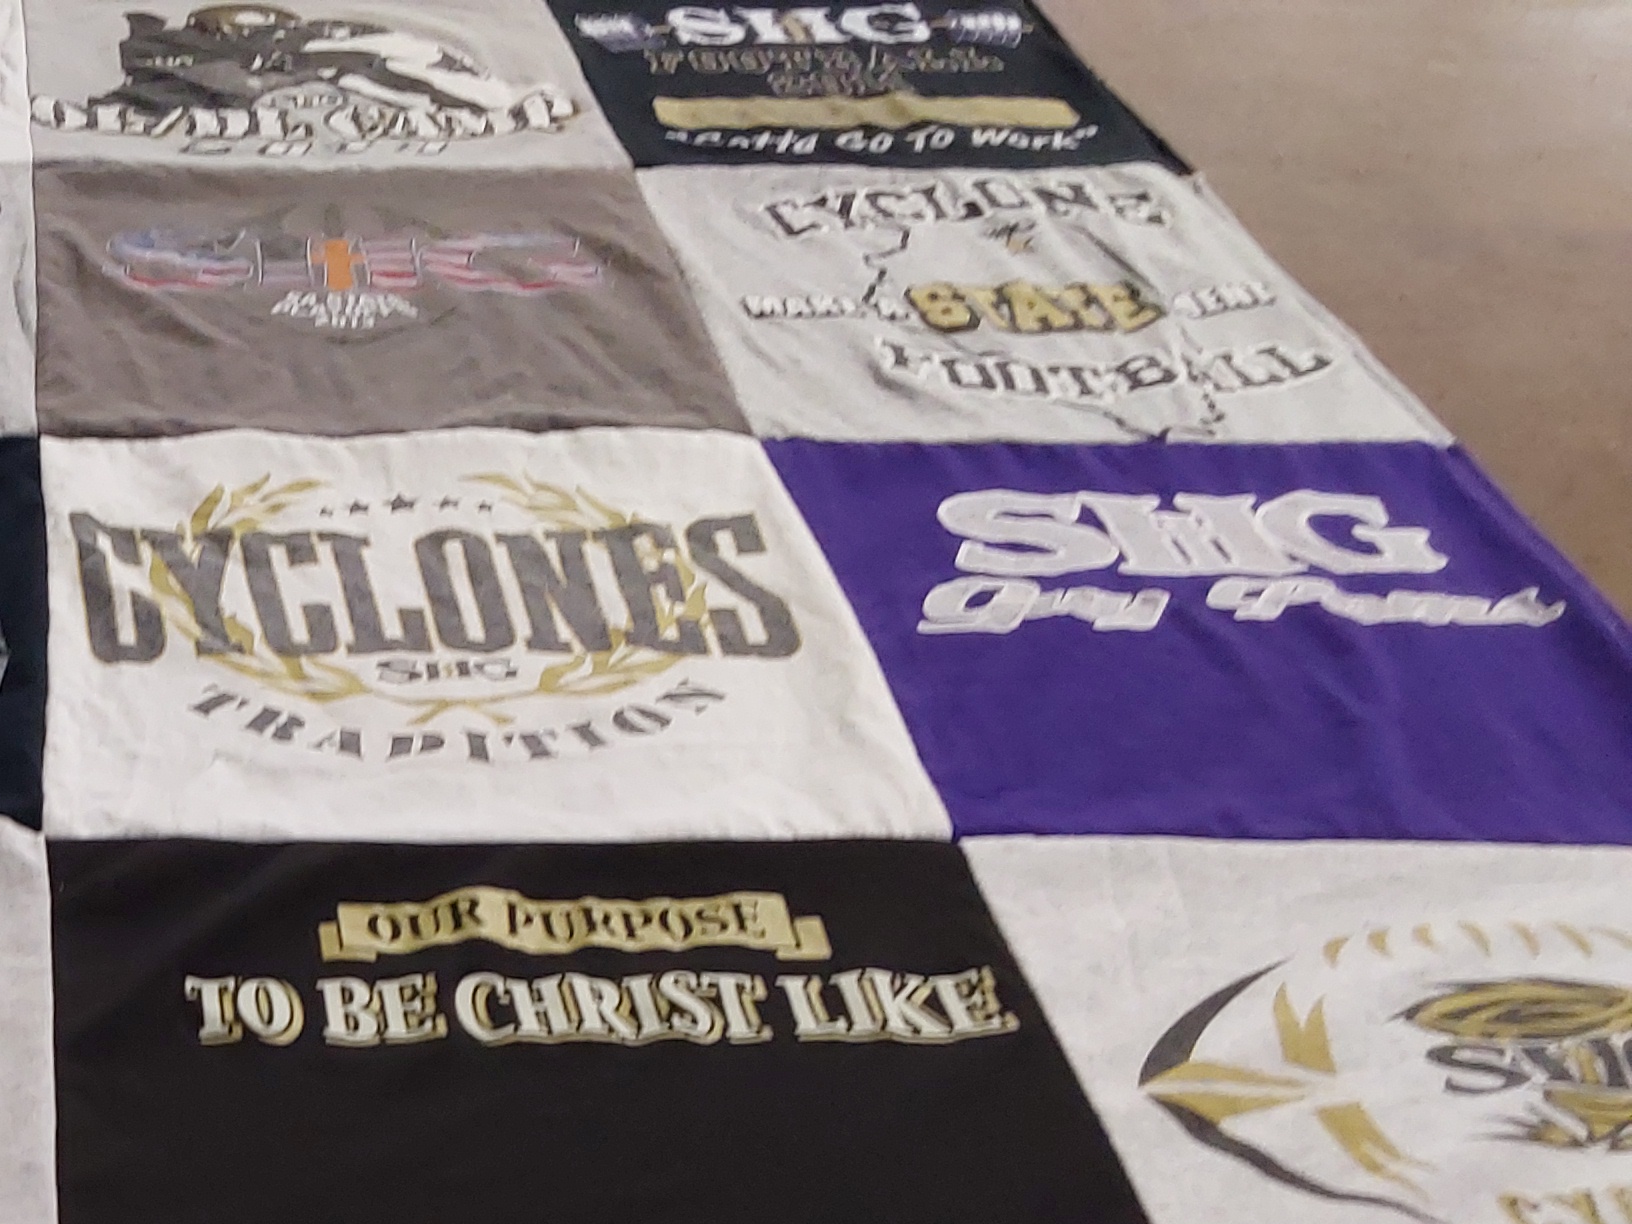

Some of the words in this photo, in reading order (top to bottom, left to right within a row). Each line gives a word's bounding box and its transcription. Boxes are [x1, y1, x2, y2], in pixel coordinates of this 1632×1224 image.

[875, 337, 1336, 399] FOOTBALL
[67, 510, 805, 665] CYCLONES
[186, 678, 726, 764] TRADITION
[367, 897, 484, 944] OUR
[507, 897, 770, 945] PURPOSE
[185, 973, 305, 1046] TO
[317, 971, 448, 1046] BE
[455, 969, 773, 1047] CHRIST
[775, 967, 1021, 1044] LIKE
